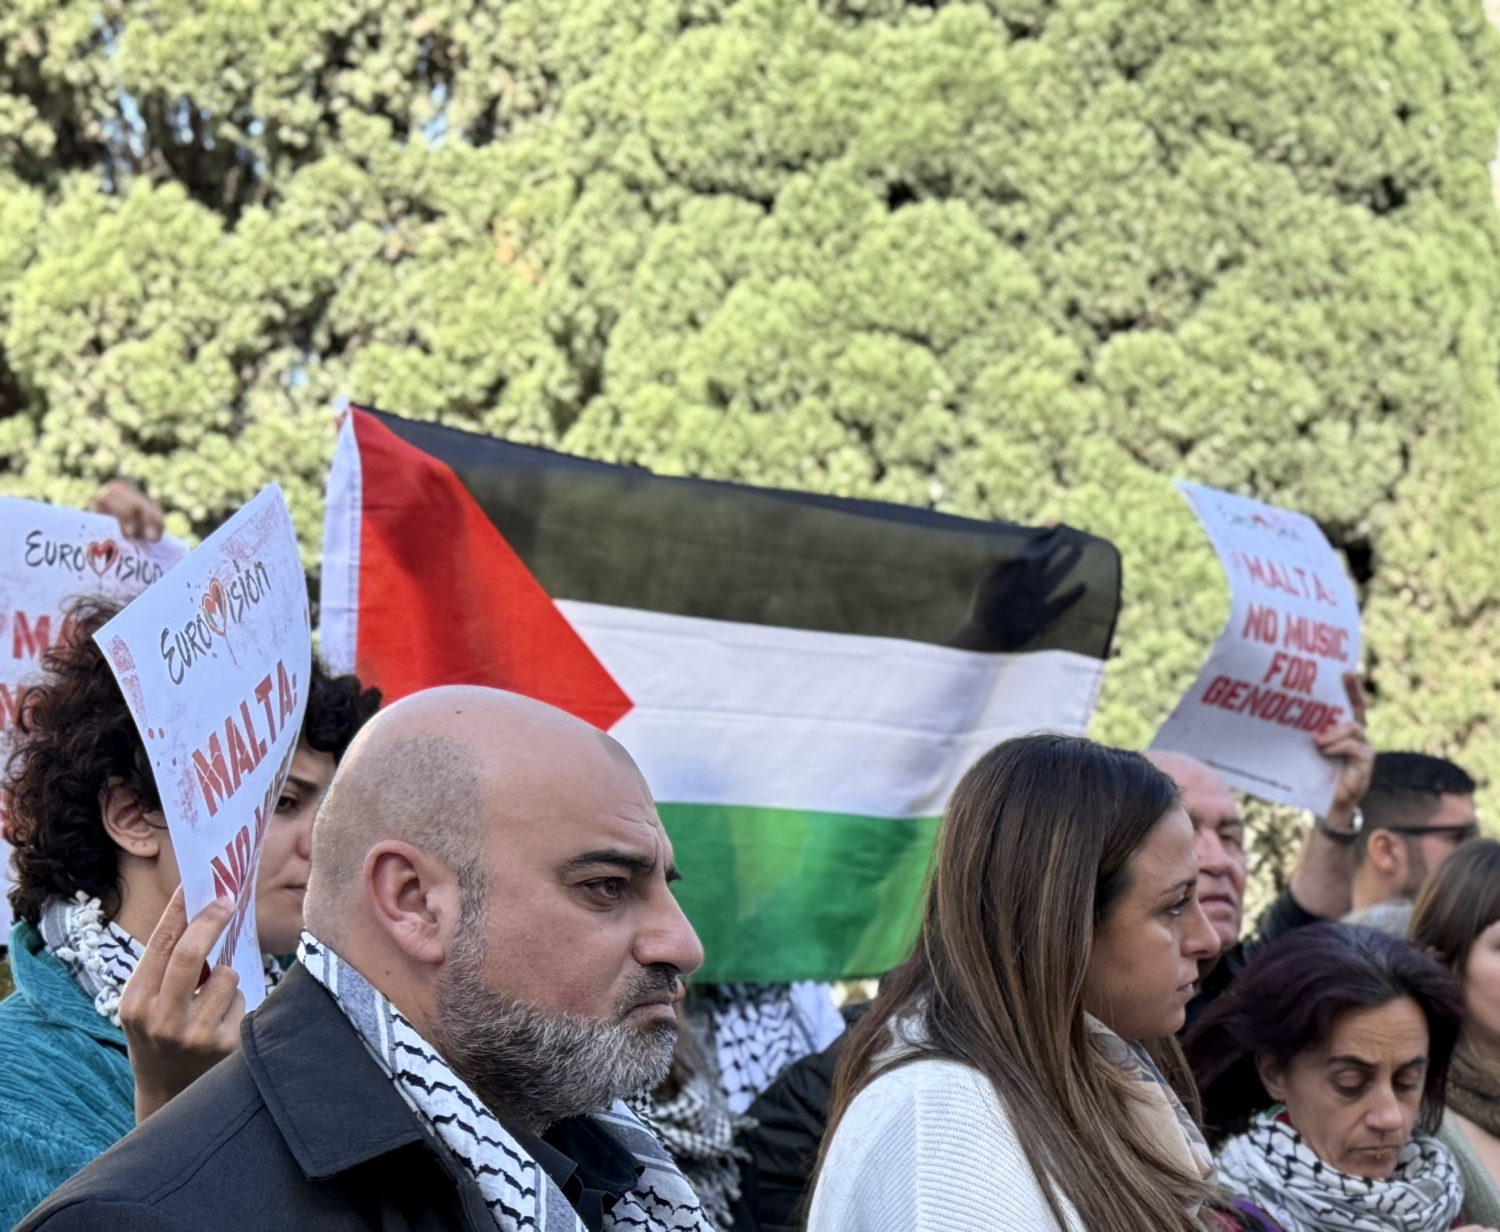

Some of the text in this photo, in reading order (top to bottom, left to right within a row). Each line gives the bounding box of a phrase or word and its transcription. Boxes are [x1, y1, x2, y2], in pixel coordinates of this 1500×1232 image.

[1242, 602, 1349, 663] NO MUSIC
[1263, 652, 1318, 695] FOR
[1201, 675, 1344, 735] GENOCIDE
[191, 659, 298, 818] MALTA:
